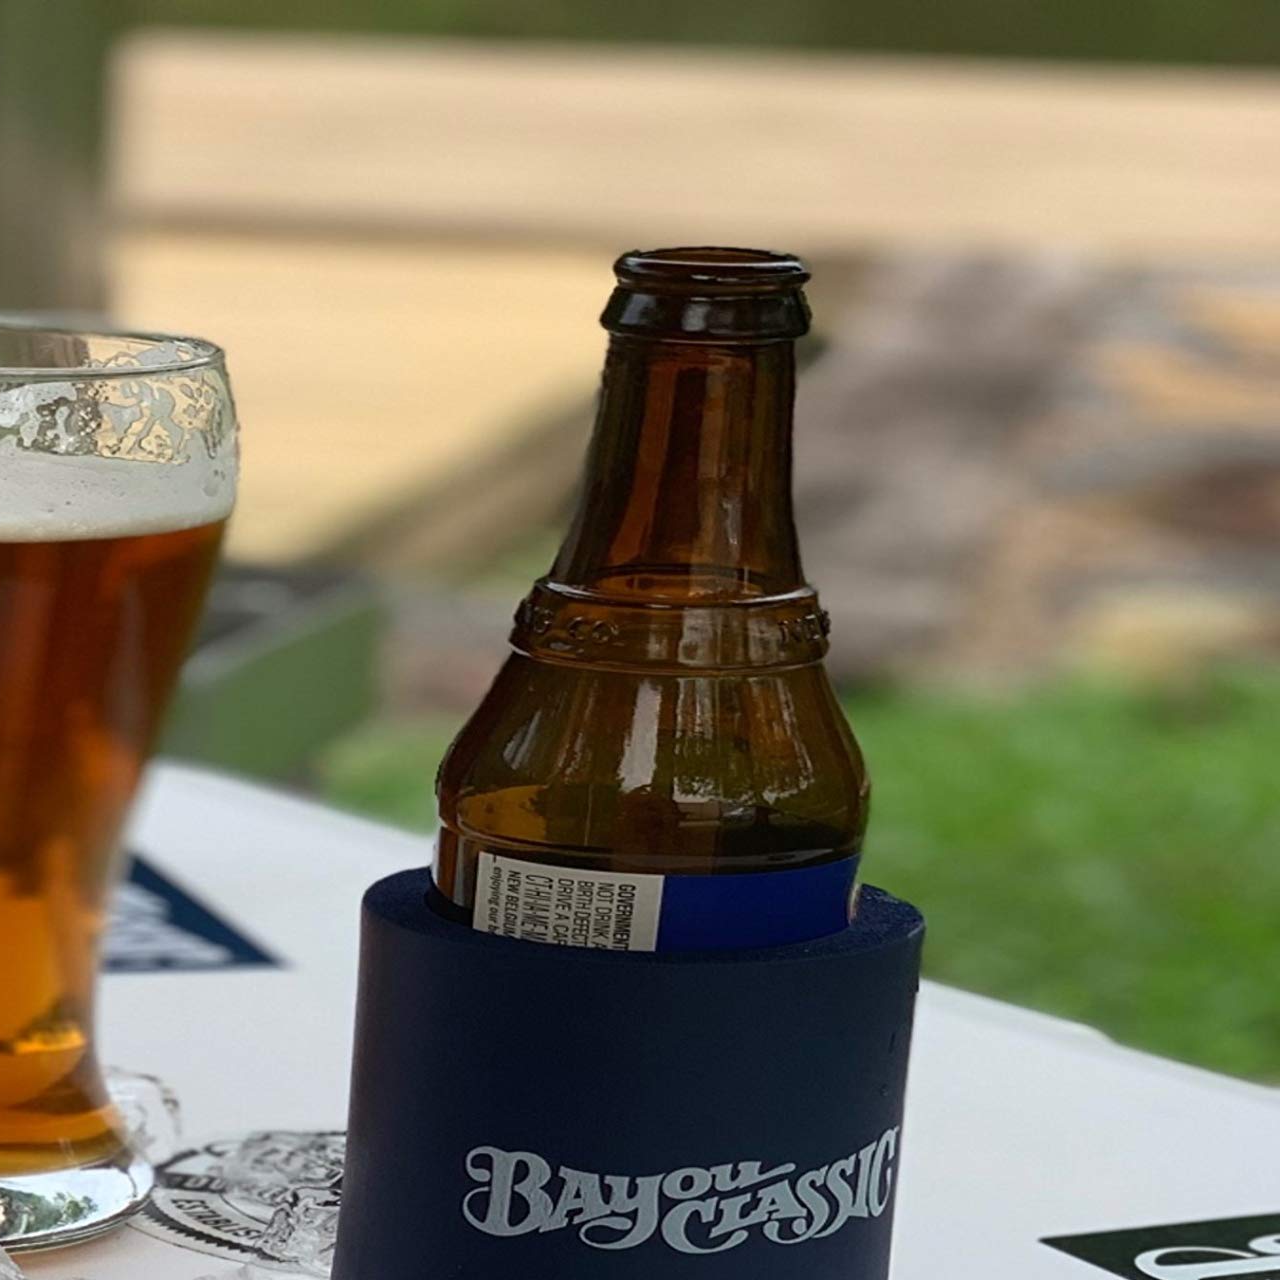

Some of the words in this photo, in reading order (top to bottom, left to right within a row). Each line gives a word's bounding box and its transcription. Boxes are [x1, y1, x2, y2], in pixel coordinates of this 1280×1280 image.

[487, 866, 503, 907] enjoying
[506, 870, 522, 894] NEW
[555, 878, 574, 916] DRIVE
[576, 881, 595, 914] BIRTH
[596, 882, 615, 905] NOT
[487, 905, 499, 924] our
[591, 906, 613, 940] DRINK
[613, 884, 636, 950] GOVERNMENT
[661, 1126, 901, 1255] CLASSIC
